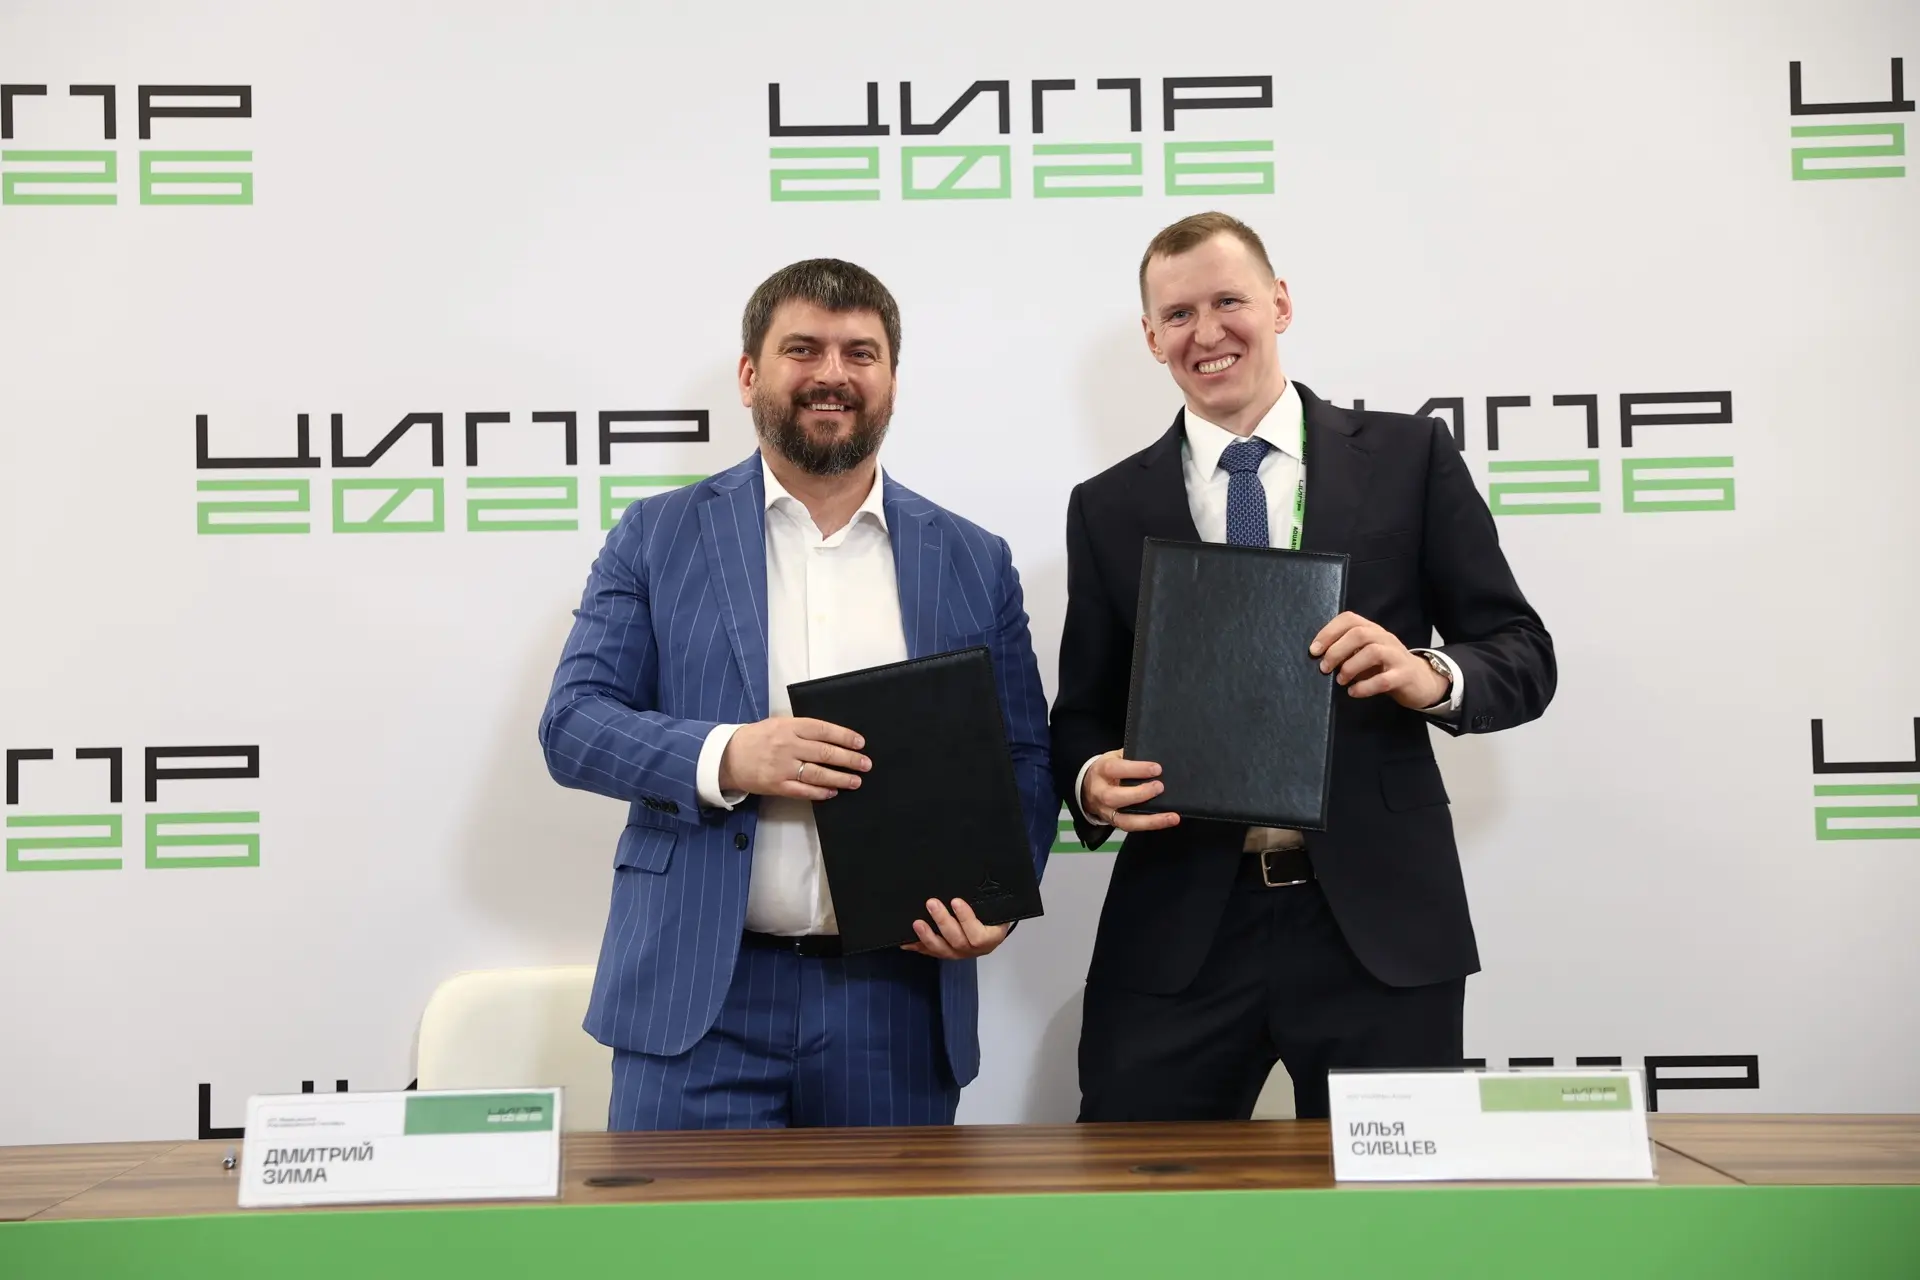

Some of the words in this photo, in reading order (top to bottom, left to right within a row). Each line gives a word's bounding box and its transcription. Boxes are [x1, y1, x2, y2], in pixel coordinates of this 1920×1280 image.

[769, 76, 1272, 136] ЦИПР
[3, 151, 252, 204] 26
[771, 141, 1274, 201] 2026
[1792, 124, 1904, 179] 2
[196, 410, 709, 468] ЦИПР
[7, 746, 259, 804] ПР
[7, 812, 260, 870] 26
[263, 1141, 374, 1166] ДМИТРИЙ
[1349, 1122, 1405, 1137] ИЛЬЯ
[1351, 1140, 1437, 1157] СИВЦЕВ
[263, 1167, 328, 1185] ЗИМА
